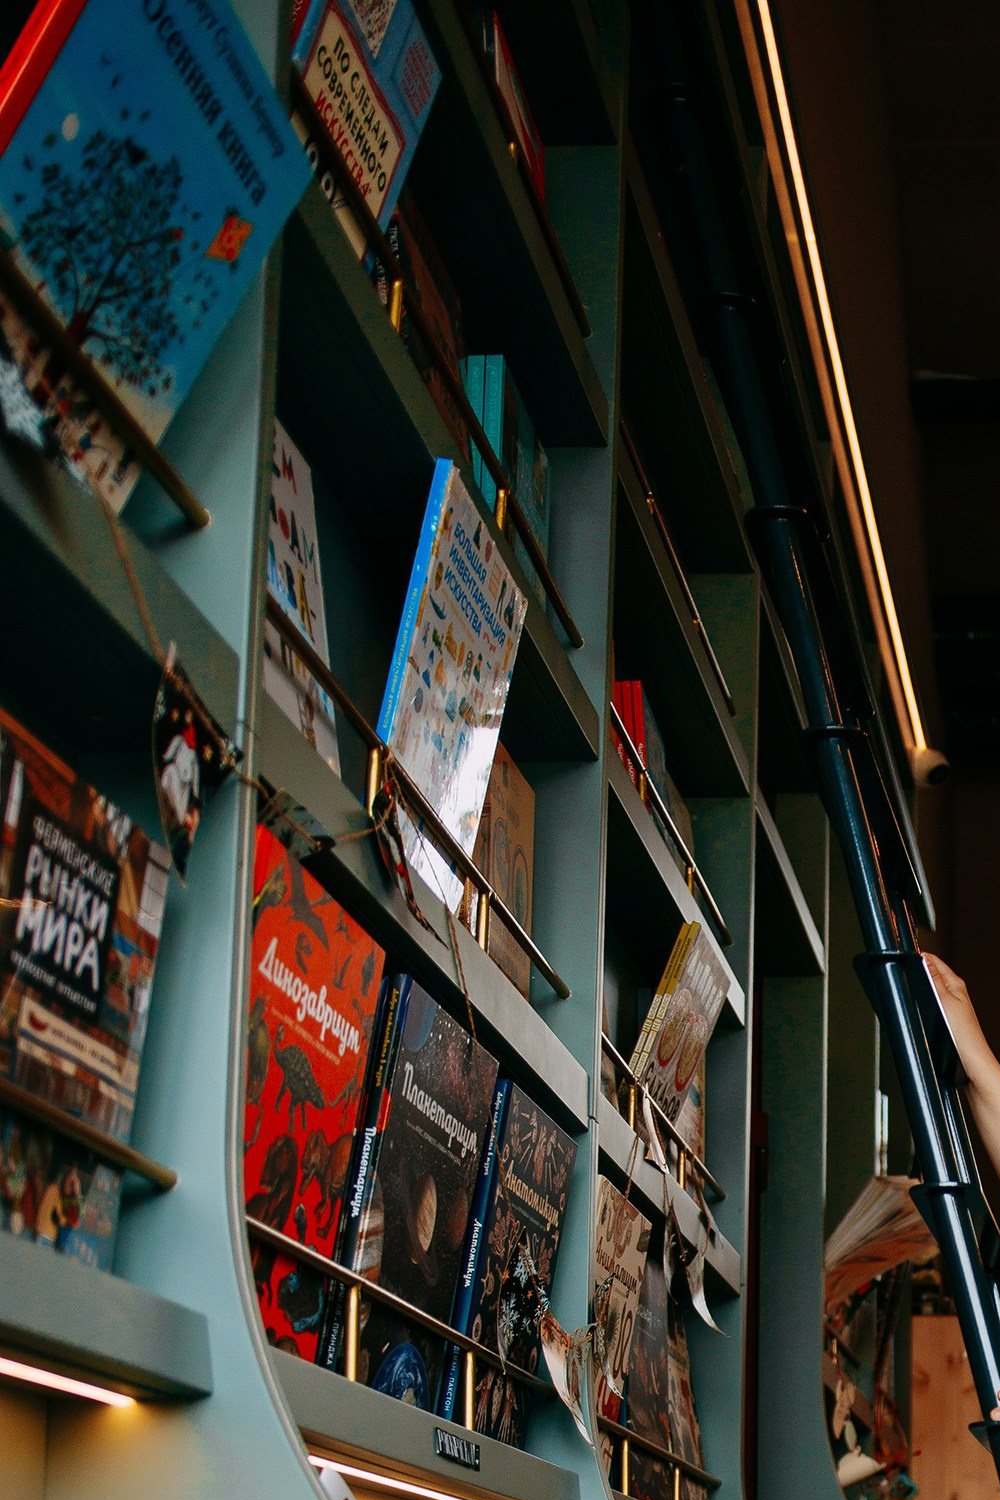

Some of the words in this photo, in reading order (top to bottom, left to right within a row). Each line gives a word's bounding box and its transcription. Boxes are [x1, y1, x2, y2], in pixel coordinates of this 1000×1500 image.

[317, 45, 386, 192] СОВРЕМЕННОГО
[333, 34, 350, 73] ПО
[351, 71, 389, 158] СЛЕДАМ
[449, 543, 506, 648] ИНВЕНТАРИЗАЦИЯ
[453, 521, 487, 585] БОЛЬШАЯ
[444, 565, 482, 638] ИСКУССТВА
[16, 886, 100, 993] МИРА
[25, 843, 110, 942] РЫНКИ
[258, 936, 360, 1057] Динозавриум
[402, 1061, 478, 1159] Планетариум
[351, 1126, 377, 1219] Планетариум
[504, 1159, 560, 1232] Анатомикум
[464, 1218, 482, 1288] Анатомикум
[326, 1322, 340, 1366] ПРИНДЖА
[444, 1377, 456, 1412] ПАКСТОН
